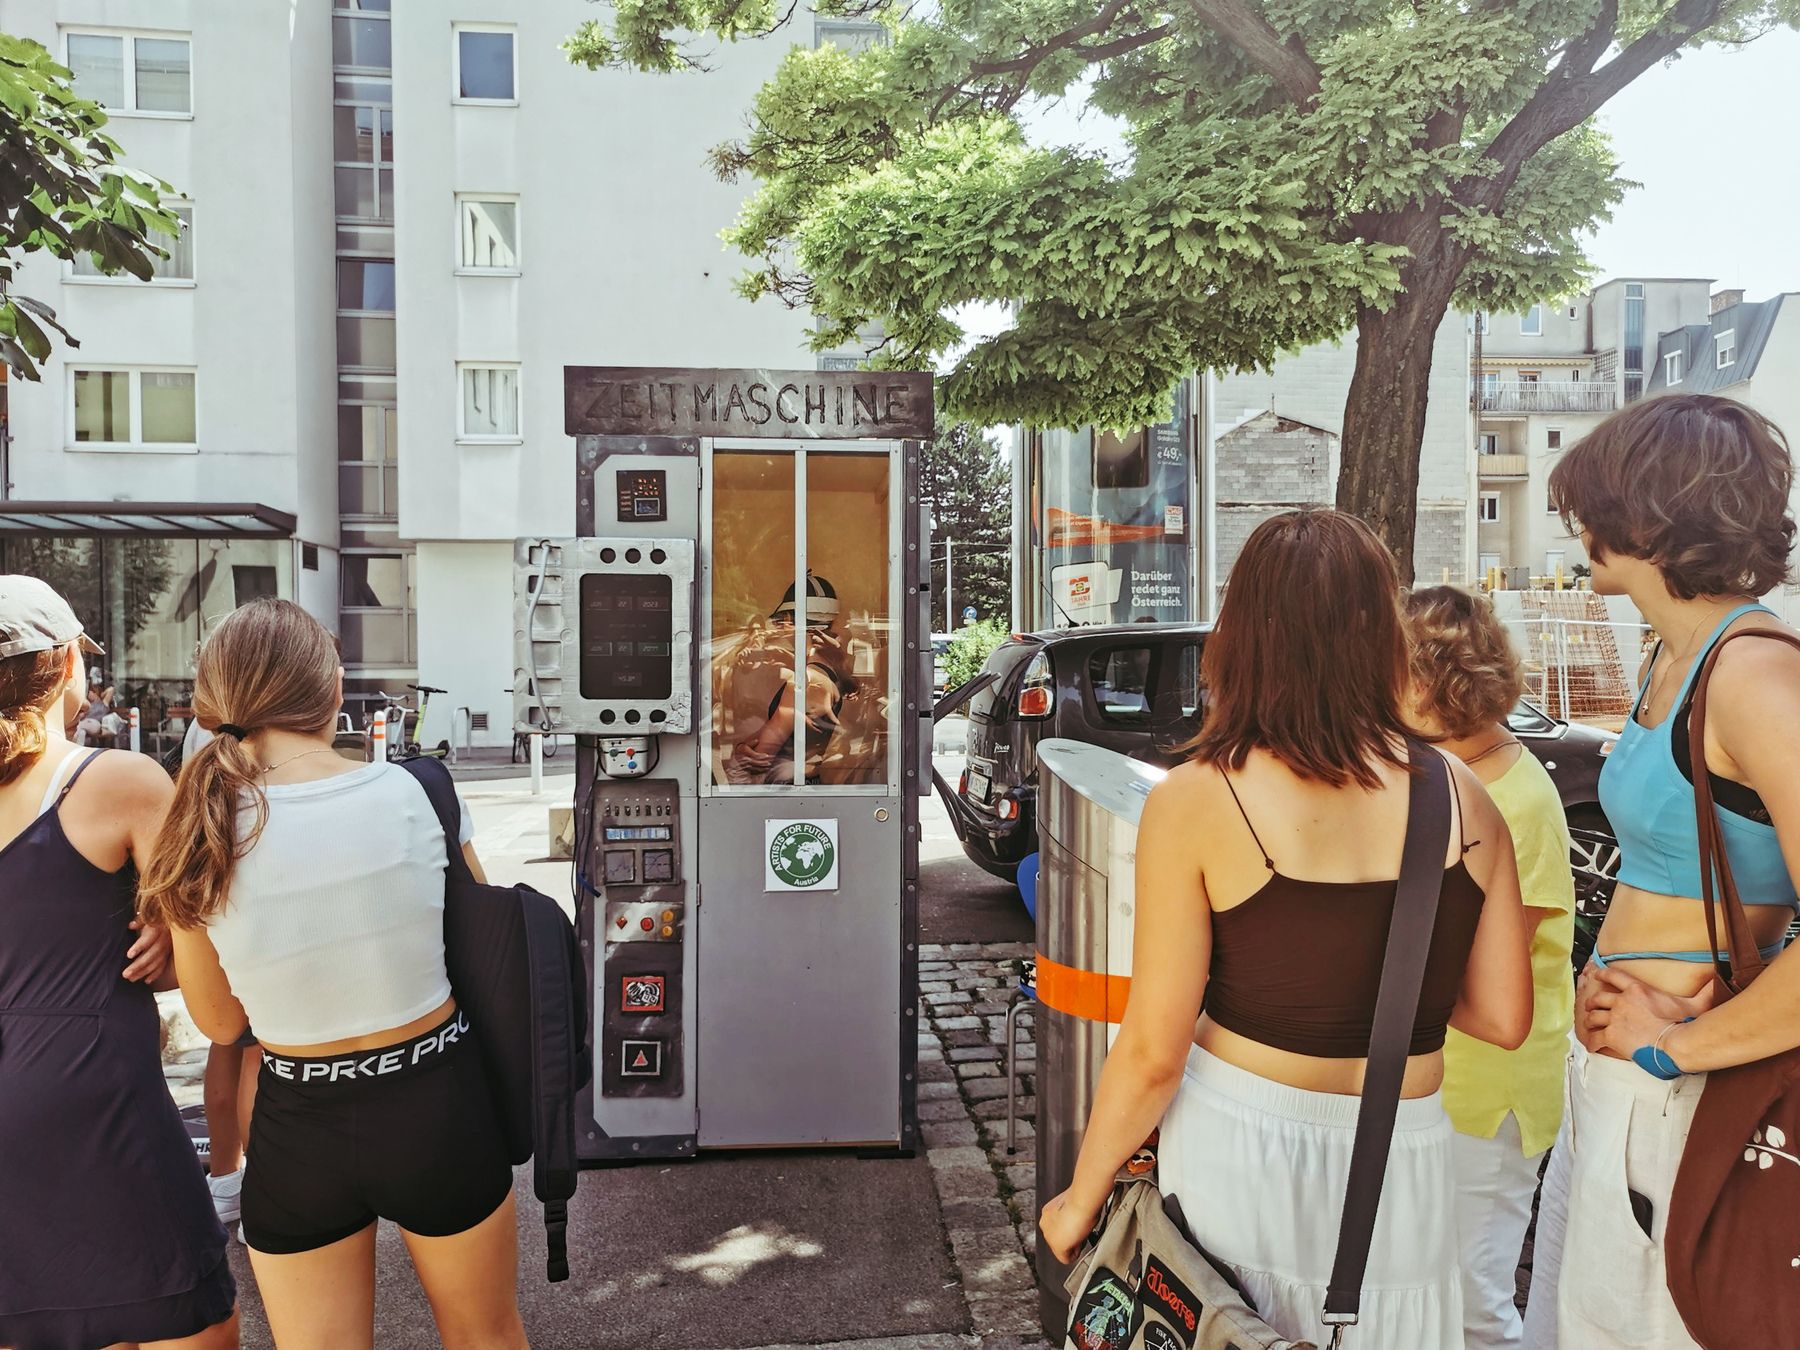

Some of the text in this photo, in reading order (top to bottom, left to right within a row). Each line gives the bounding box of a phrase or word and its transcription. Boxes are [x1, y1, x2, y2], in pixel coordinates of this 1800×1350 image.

[585, 382, 910, 426] ZEITMASCHINE
[1131, 570, 1173, 581] Darüber
[1131, 584, 1181, 596] redet ganz
[1131, 595, 1183, 607] Österreich.
[771, 824, 832, 871] ARTISTS FOR FUTURE
[793, 876, 819, 886] Austria
